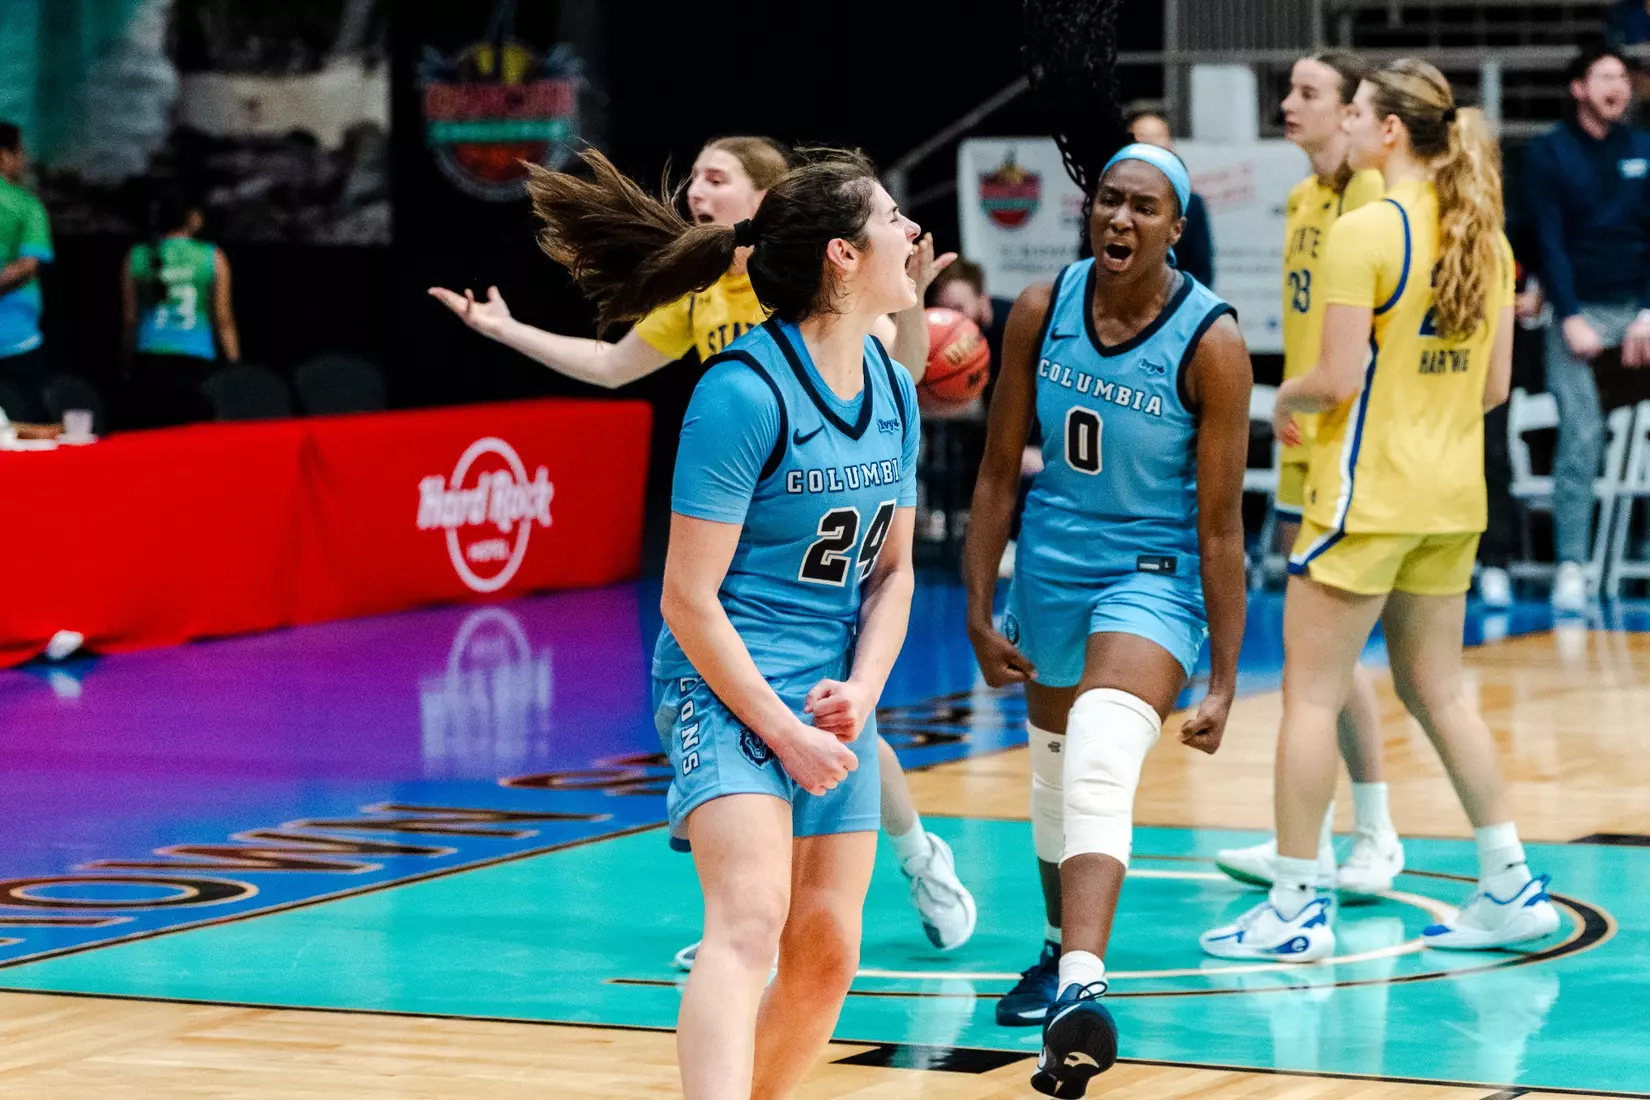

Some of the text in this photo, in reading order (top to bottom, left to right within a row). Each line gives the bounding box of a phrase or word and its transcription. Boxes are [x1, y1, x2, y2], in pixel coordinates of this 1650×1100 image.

[1036, 356, 1164, 418] COLUMBIA
[1063, 404, 1104, 476] 0
[416, 465, 555, 533] Hard Rock
[786, 458, 903, 495] COLUMBI
[797, 498, 897, 588] 24
